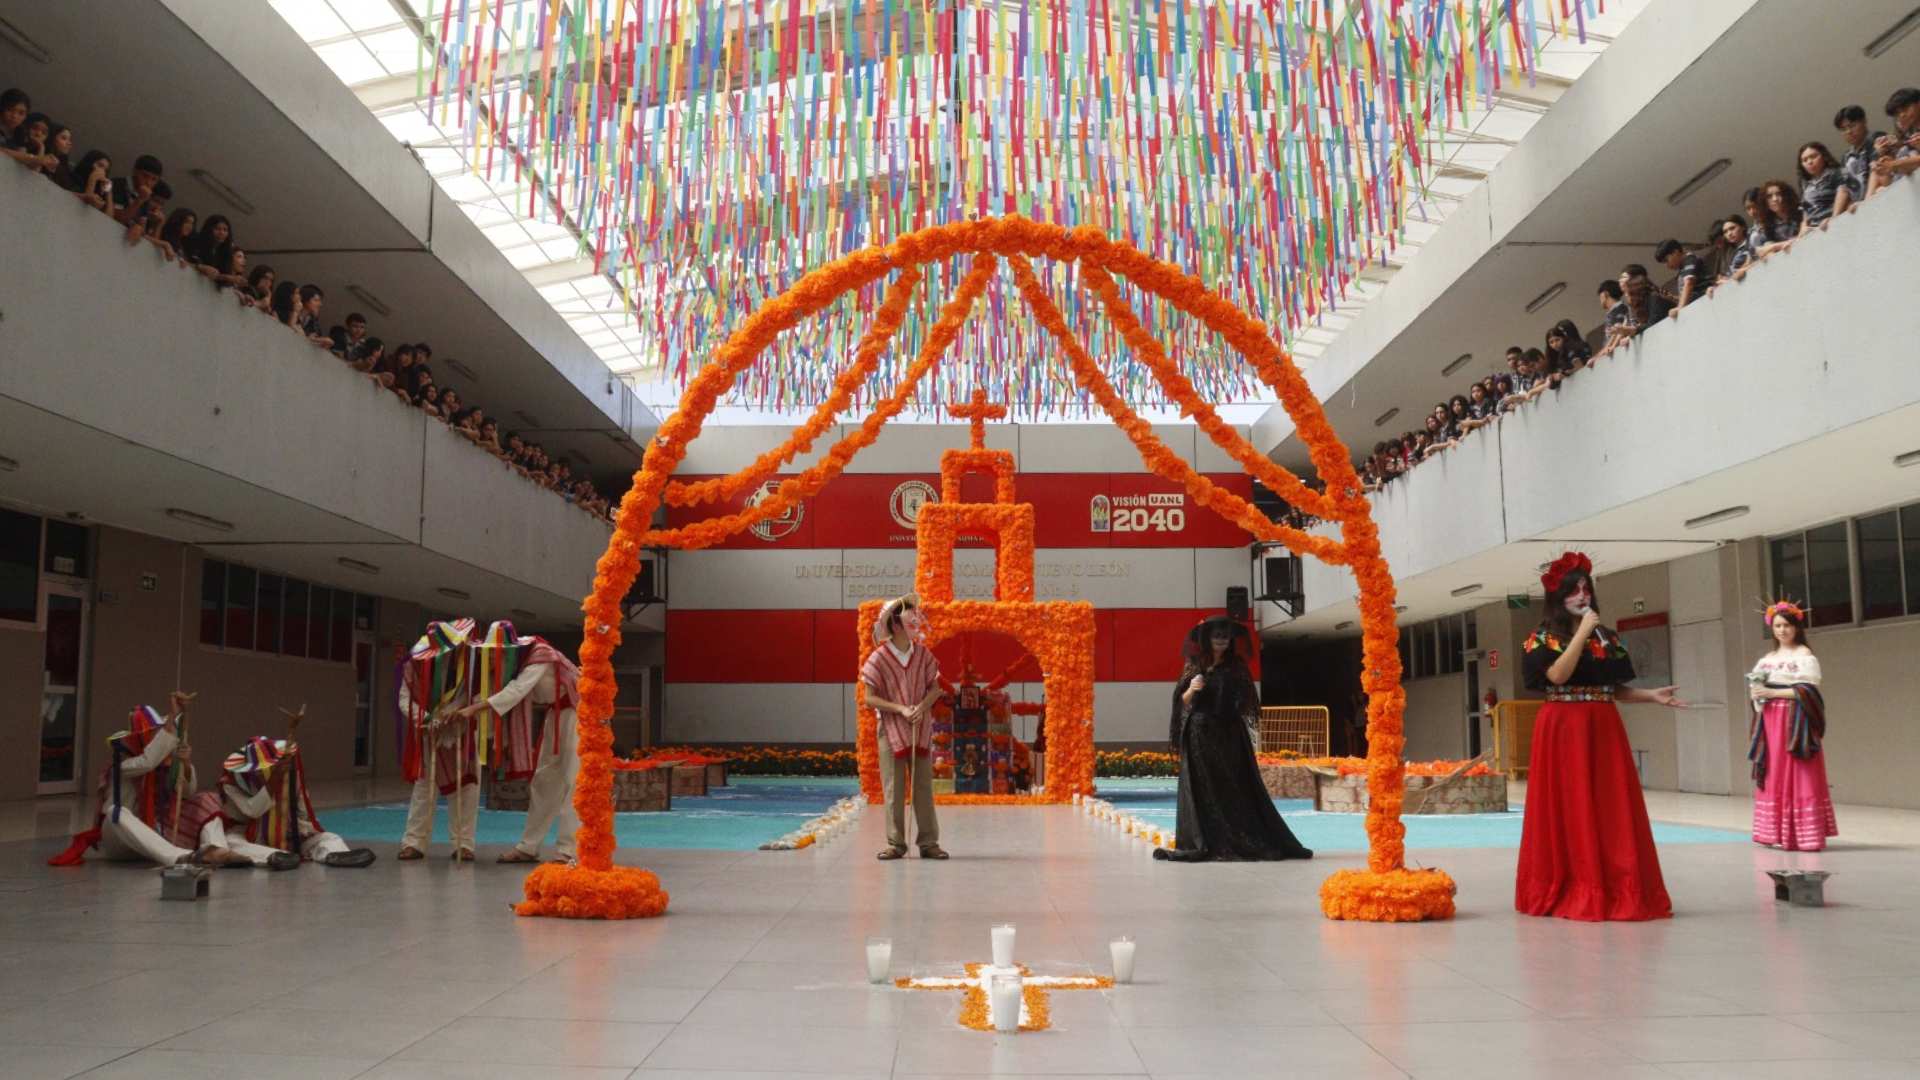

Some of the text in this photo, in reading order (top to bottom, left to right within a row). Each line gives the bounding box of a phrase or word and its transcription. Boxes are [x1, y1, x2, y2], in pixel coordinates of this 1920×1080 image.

[1112, 493, 1184, 507] VISIÓN UANL
[1112, 508, 1185, 532] 2040
